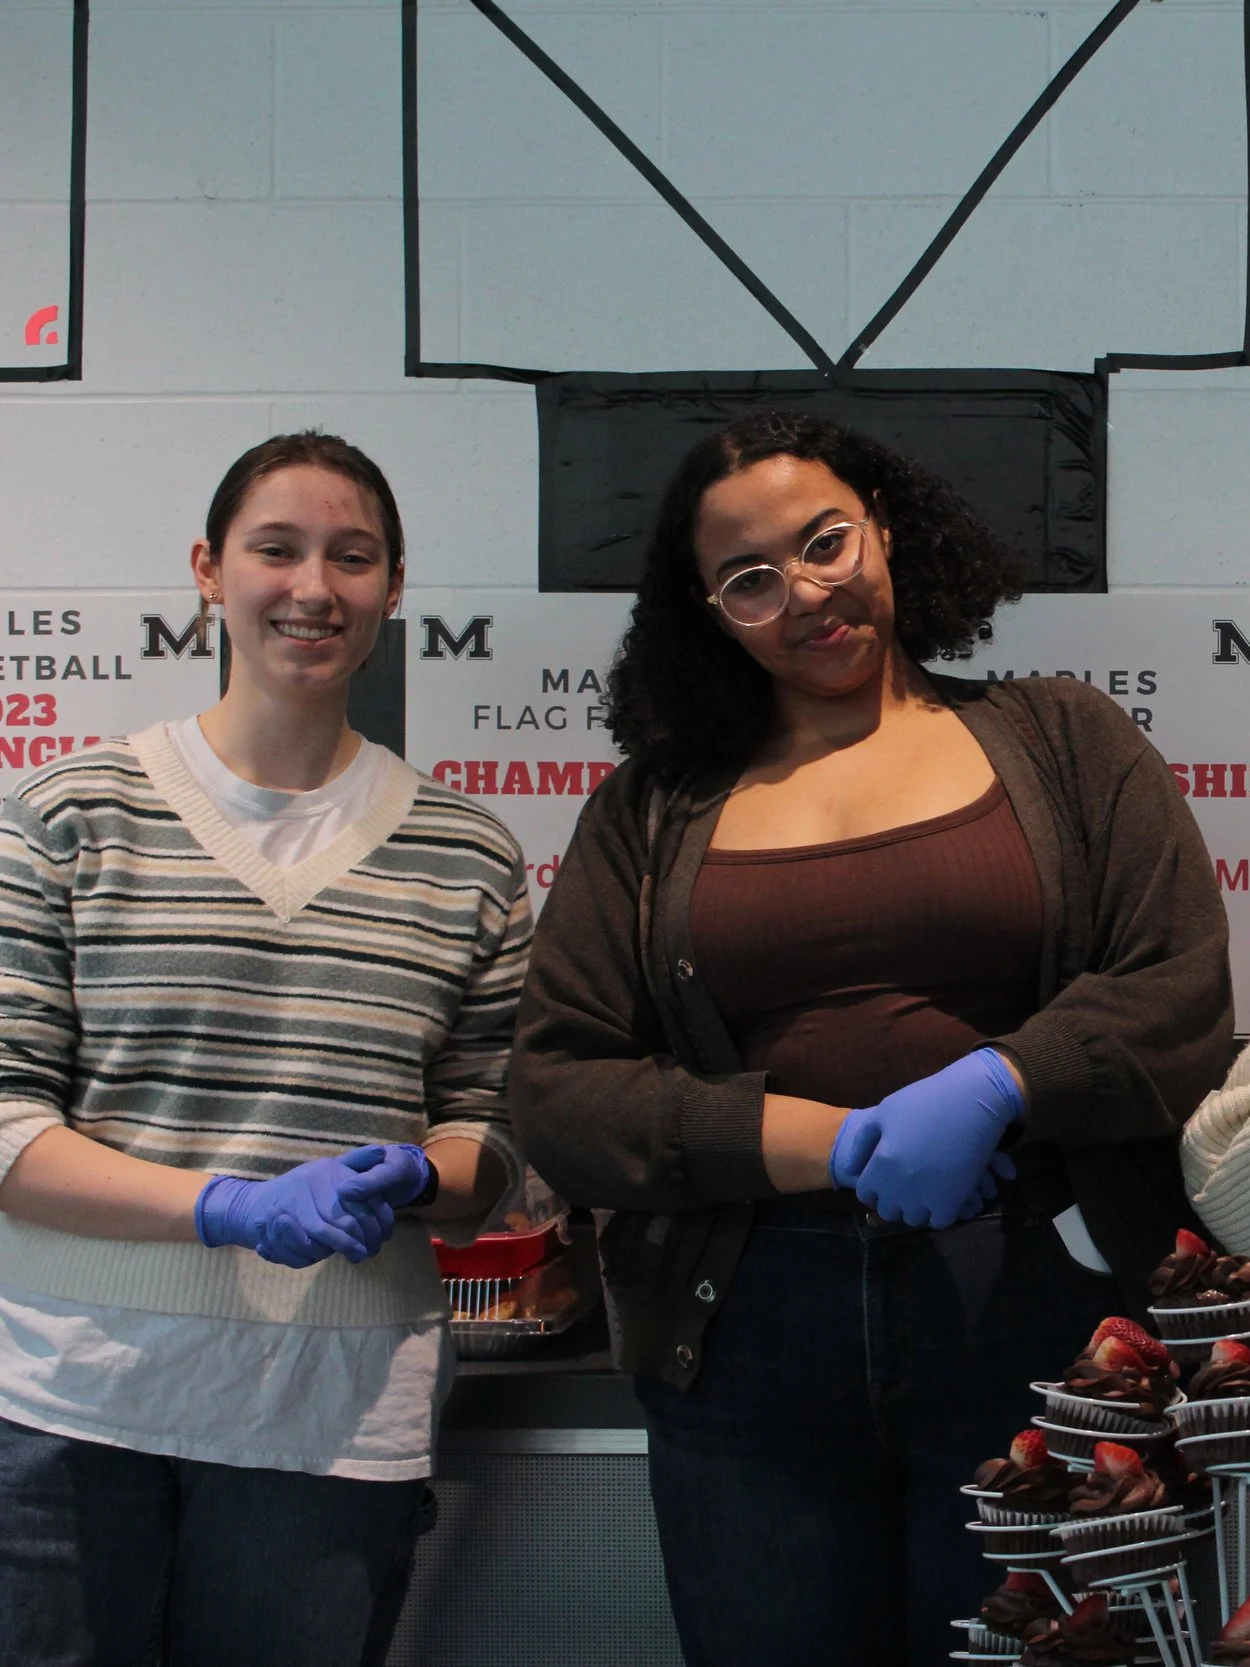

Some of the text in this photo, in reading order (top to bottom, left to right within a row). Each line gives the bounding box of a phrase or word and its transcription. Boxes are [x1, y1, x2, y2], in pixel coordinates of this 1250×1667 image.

[420, 615, 494, 661] M
[0, 655, 132, 681] TBALL
[0, 693, 57, 726] 23
[474, 705, 568, 730] FLAG
